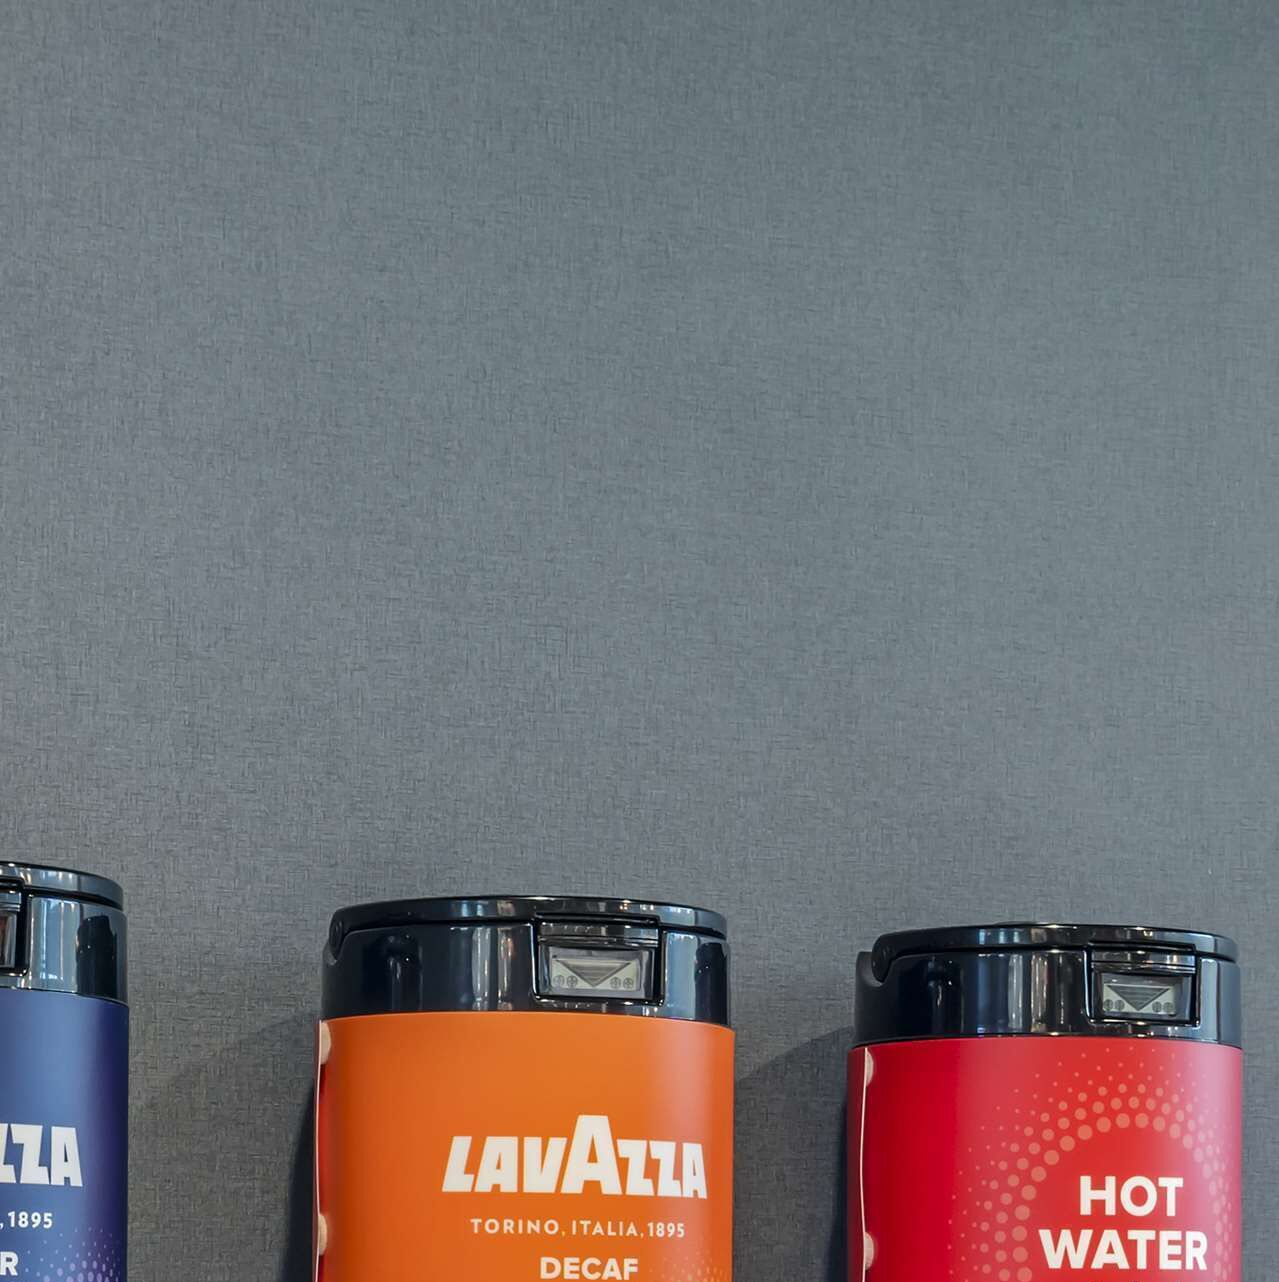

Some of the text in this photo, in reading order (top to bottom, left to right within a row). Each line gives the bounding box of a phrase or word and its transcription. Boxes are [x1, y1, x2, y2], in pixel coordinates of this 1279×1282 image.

[441, 1114, 707, 1200] LAVAZZA
[1079, 1175, 1184, 1217] HOT
[7, 1210, 54, 1229] 1895
[470, 1218, 686, 1239] TORINO, ITALIA, 1895
[1038, 1228, 1208, 1271] WATER
[539, 1256, 639, 1281] DECAF
